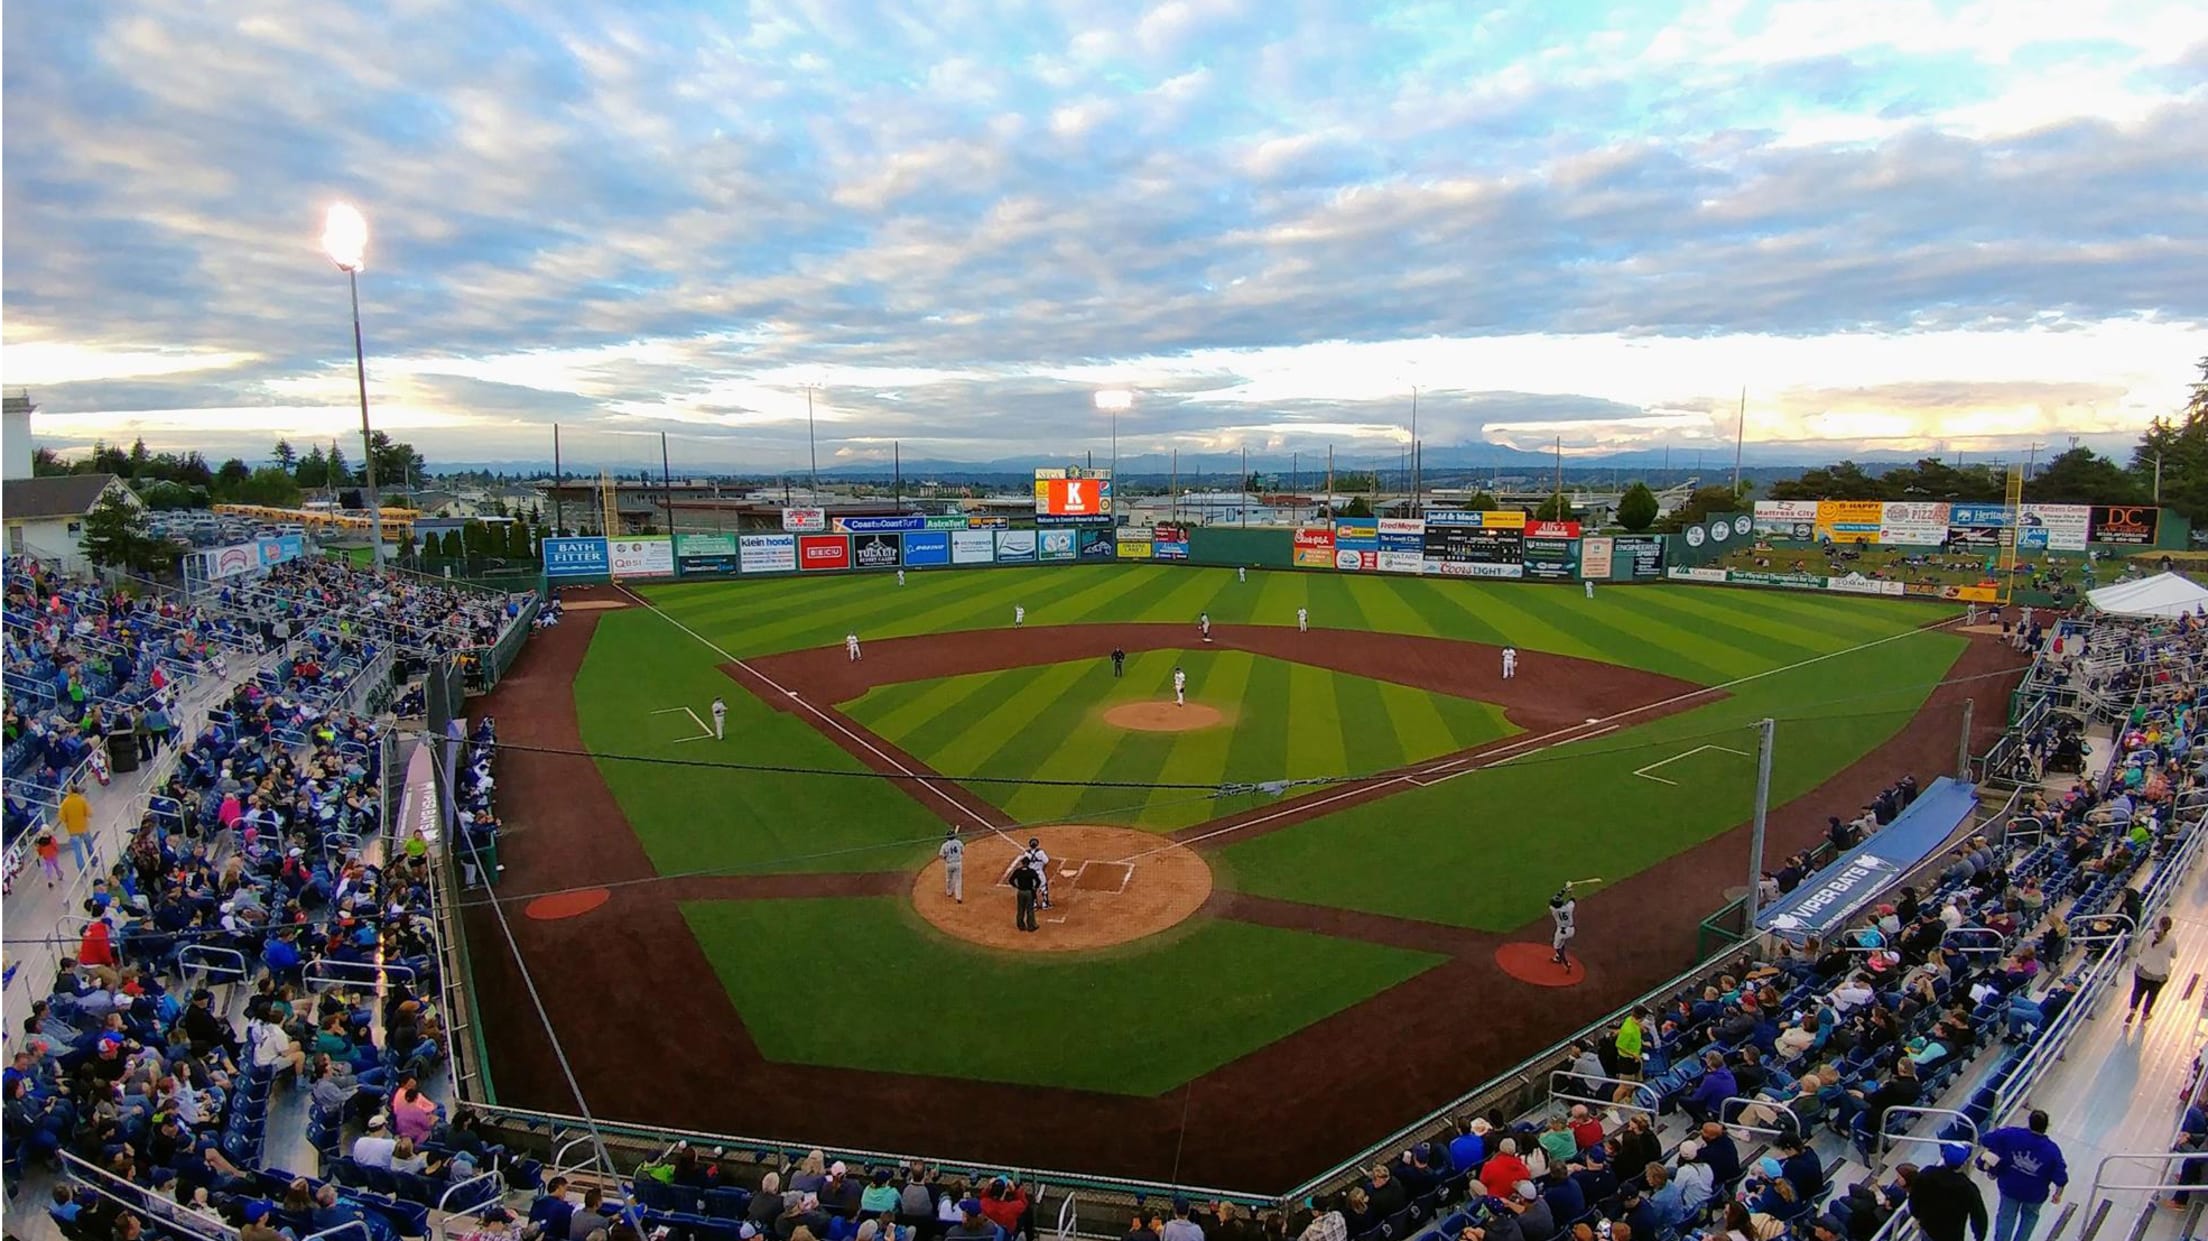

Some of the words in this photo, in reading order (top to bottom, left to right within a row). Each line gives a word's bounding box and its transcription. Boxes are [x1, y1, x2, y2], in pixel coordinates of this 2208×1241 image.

[1067, 482, 1082, 504] K
[2108, 508, 2143, 526] DC
[851, 521, 875, 529] Coast
[880, 520, 902, 528] Coast
[1397, 522, 1420, 530] Meyer
[741, 538, 765, 547] klein
[766, 536, 793, 546] honda
[558, 543, 595, 552] BATH
[555, 552, 601, 561] FITTER
[857, 548, 897, 558] TULALIP
[1440, 562, 1472, 575] Coors
[1473, 567, 1502, 576] LIGHT
[1790, 888, 1841, 918] VIPER
[1828, 866, 1870, 892] BATS
